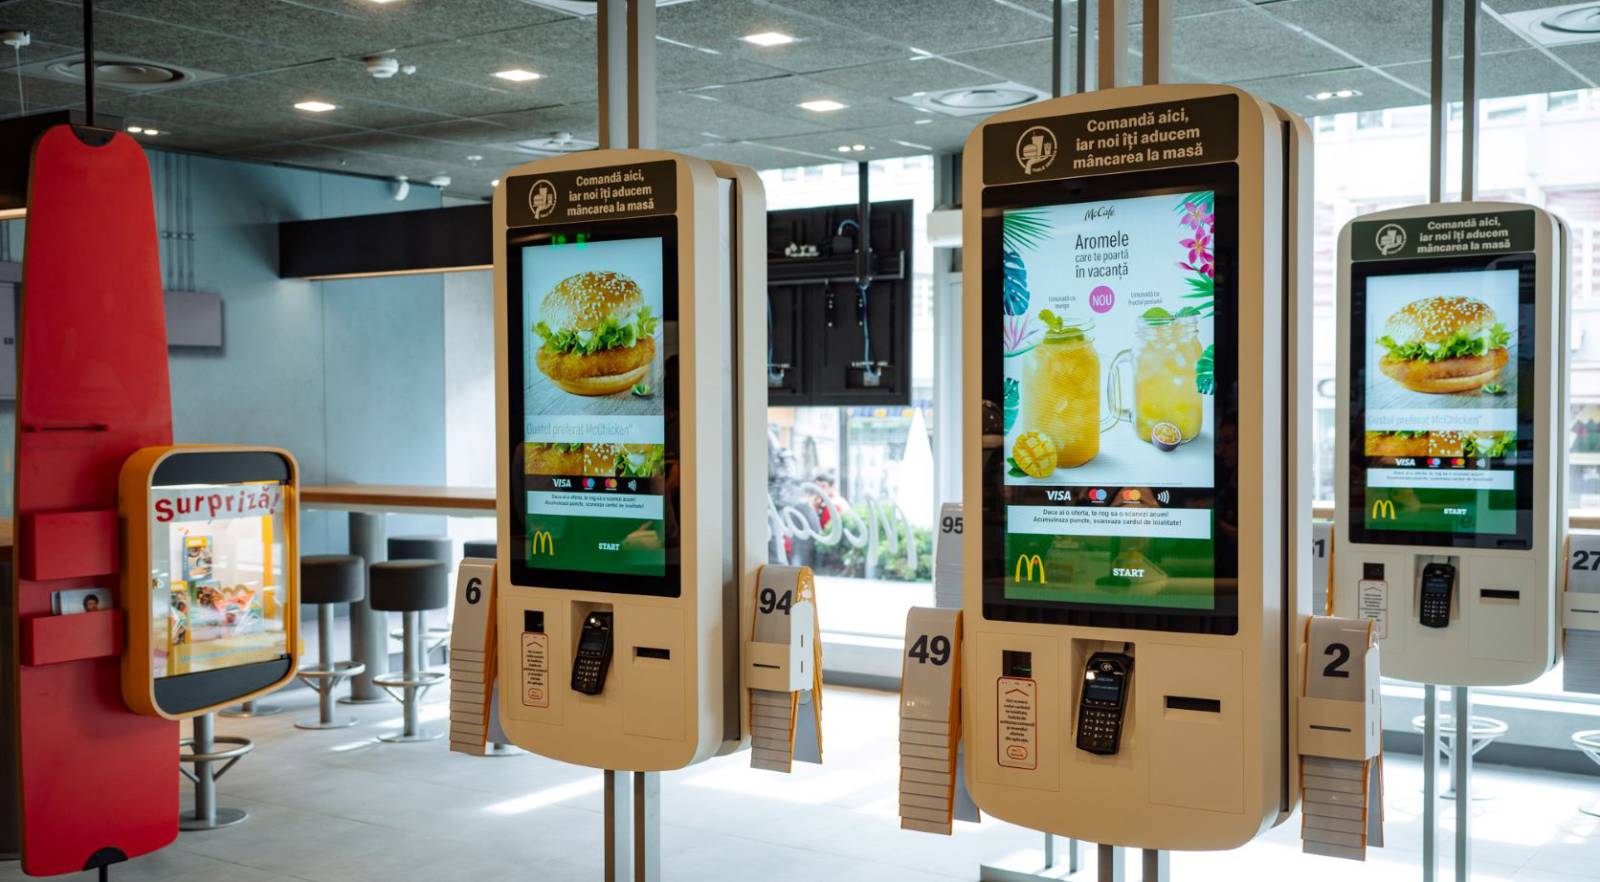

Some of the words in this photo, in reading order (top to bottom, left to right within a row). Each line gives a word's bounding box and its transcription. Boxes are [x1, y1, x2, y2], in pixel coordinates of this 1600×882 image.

[1087, 111, 1156, 133] Comandă
[1158, 107, 1190, 125] aici,
[1076, 138, 1097, 153] iar
[1097, 134, 1120, 150] noi
[1139, 127, 1201, 145] aducem
[1073, 152, 1143, 170] mâncarea
[1147, 148, 1159, 163] la
[1162, 142, 1204, 161] masă
[576, 171, 623, 188] Comandă
[624, 168, 645, 183] aici,
[569, 190, 582, 202] iar
[583, 188, 599, 201] noi
[612, 186, 652, 199] aducem
[567, 203, 615, 217] mâncarea
[616, 201, 626, 212] la
[627, 198, 655, 211] masă
[1427, 218, 1477, 231] Comandă
[1479, 216, 1501, 228] aici,
[1075, 230, 1130, 250] Aromele
[1419, 232, 1433, 243] iar
[1434, 231, 1452, 242] noi
[1466, 228, 1509, 240] aducem
[1417, 243, 1468, 254] mâncarea
[1470, 241, 1480, 251] la
[1482, 238, 1511, 250] masă
[1075, 253, 1092, 263] care
[1094, 252, 1102, 262] te
[1075, 264, 1086, 279] în
[1091, 294, 1113, 307] NOU
[1395, 457, 1417, 467] VISA
[552, 478, 572, 489] VISA
[1045, 490, 1072, 502] VISA
[155, 487, 281, 523] Surpriză!
[1443, 507, 1468, 516] START
[942, 515, 963, 535] 95
[598, 542, 620, 551] START
[1572, 550, 1600, 571] 27
[1112, 567, 1145, 578] START
[465, 577, 482, 605] 6
[760, 587, 793, 616] 94
[908, 633, 951, 667] 49
[1322, 642, 1350, 679] 2
